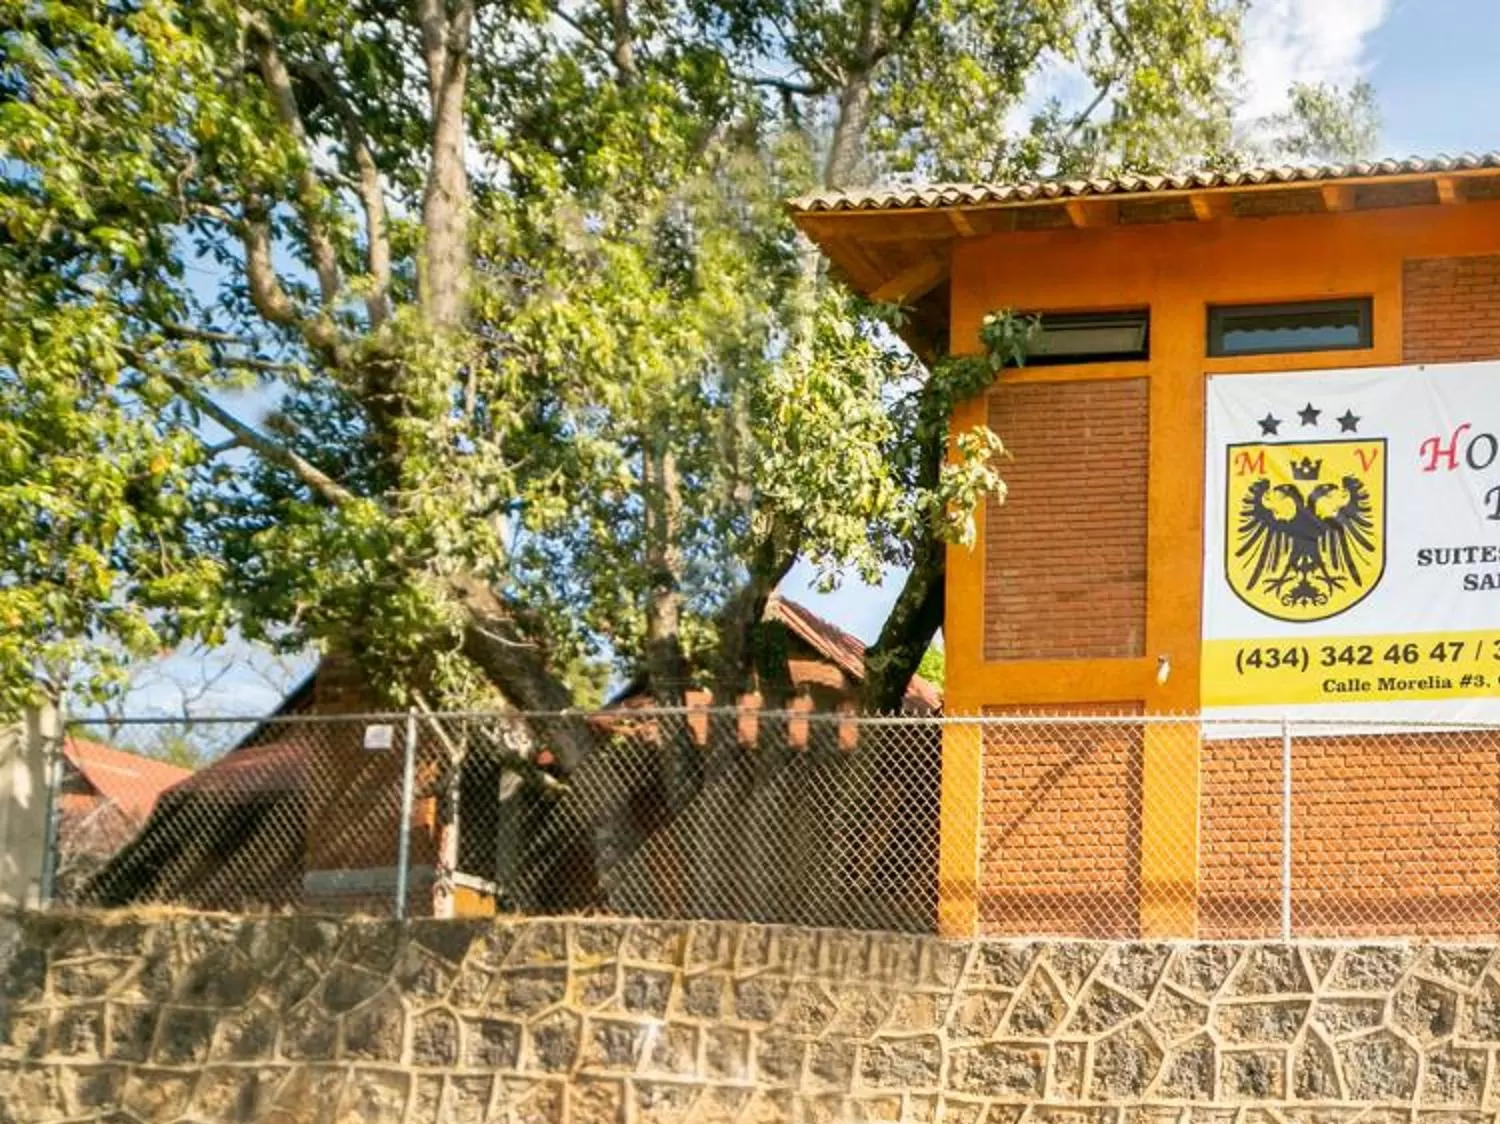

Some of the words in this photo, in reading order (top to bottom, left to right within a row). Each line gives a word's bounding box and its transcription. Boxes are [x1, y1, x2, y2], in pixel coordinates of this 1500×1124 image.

[1235, 450, 1266, 476] M
[1354, 448, 1378, 472] V
[1236, 646, 1310, 674] (434)
[1320, 645, 1373, 667] 342
[1384, 643, 1419, 664] 46
[1429, 641, 1464, 662] 47
[1322, 678, 1371, 693] Calle
[1377, 674, 1453, 691] Morelia
